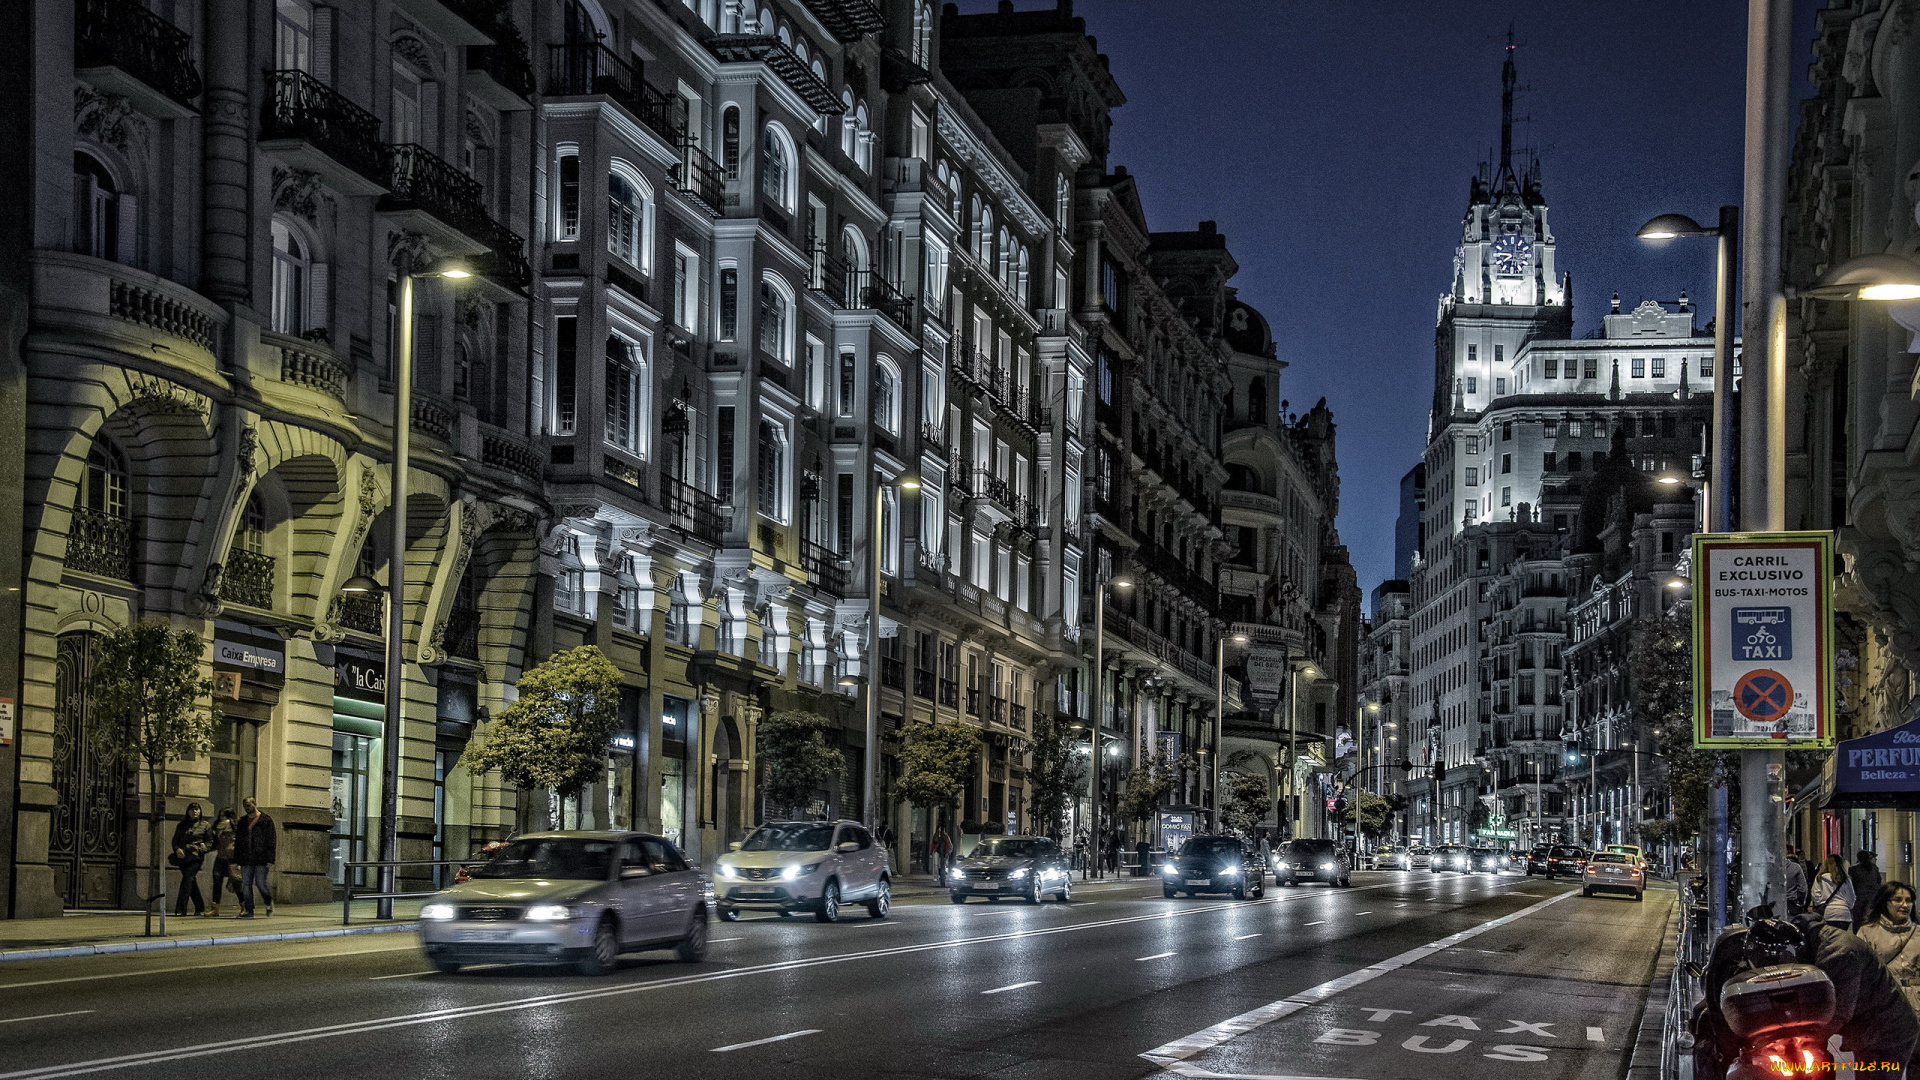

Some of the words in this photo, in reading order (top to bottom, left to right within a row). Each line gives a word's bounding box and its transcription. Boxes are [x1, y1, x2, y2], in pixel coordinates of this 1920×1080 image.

[1734, 556, 1788, 567] CARRIL
[1719, 570, 1804, 581] EXCLUSIVO
[1715, 587, 1808, 597] BUS-TAXI-MOTOS
[221, 646, 277, 669] CaixaEmpresa
[1742, 645, 1782, 658] TAXI
[1861, 770, 1907, 780] Belleza
[1360, 1007, 1605, 1042] TAXI
[1312, 1028, 1552, 1062] BUS
